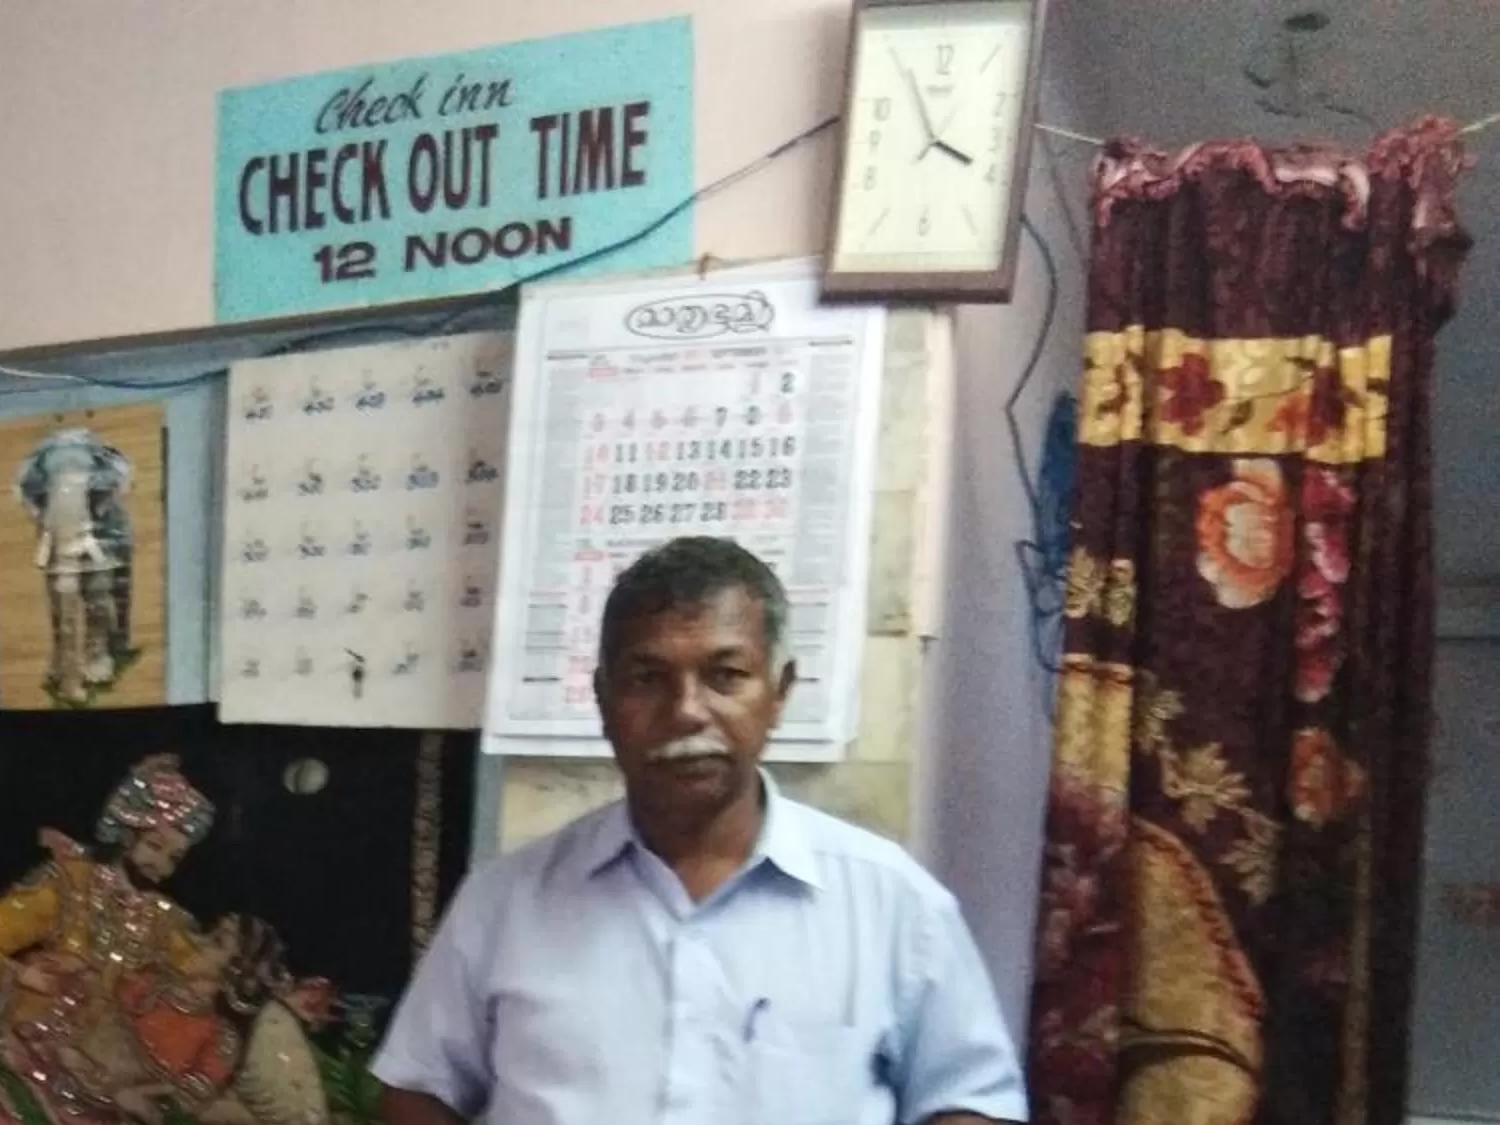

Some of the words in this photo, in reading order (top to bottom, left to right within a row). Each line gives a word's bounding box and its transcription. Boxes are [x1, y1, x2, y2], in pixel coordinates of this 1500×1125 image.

[315, 73, 423, 135] Check
[438, 73, 514, 117] inn
[239, 139, 391, 236] CHECK
[408, 124, 499, 215] OUT
[531, 101, 650, 200] TIME
[313, 242, 376, 284] 12
[404, 217, 572, 272] NOON
[780, 371, 796, 394] 2
[615, 443, 638, 463] 11
[676, 440, 701, 461] 13
[706, 439, 732, 460] 14
[738, 437, 765, 459] 15
[768, 436, 797, 458] 16
[612, 473, 637, 494] 18
[643, 472, 669, 493] 19
[671, 471, 700, 492] 20
[734, 468, 762, 490] 22
[765, 467, 792, 489] 23
[609, 504, 637, 525] 25
[639, 503, 665, 524] 26
[669, 502, 697, 524] 27
[700, 501, 727, 522] 28
